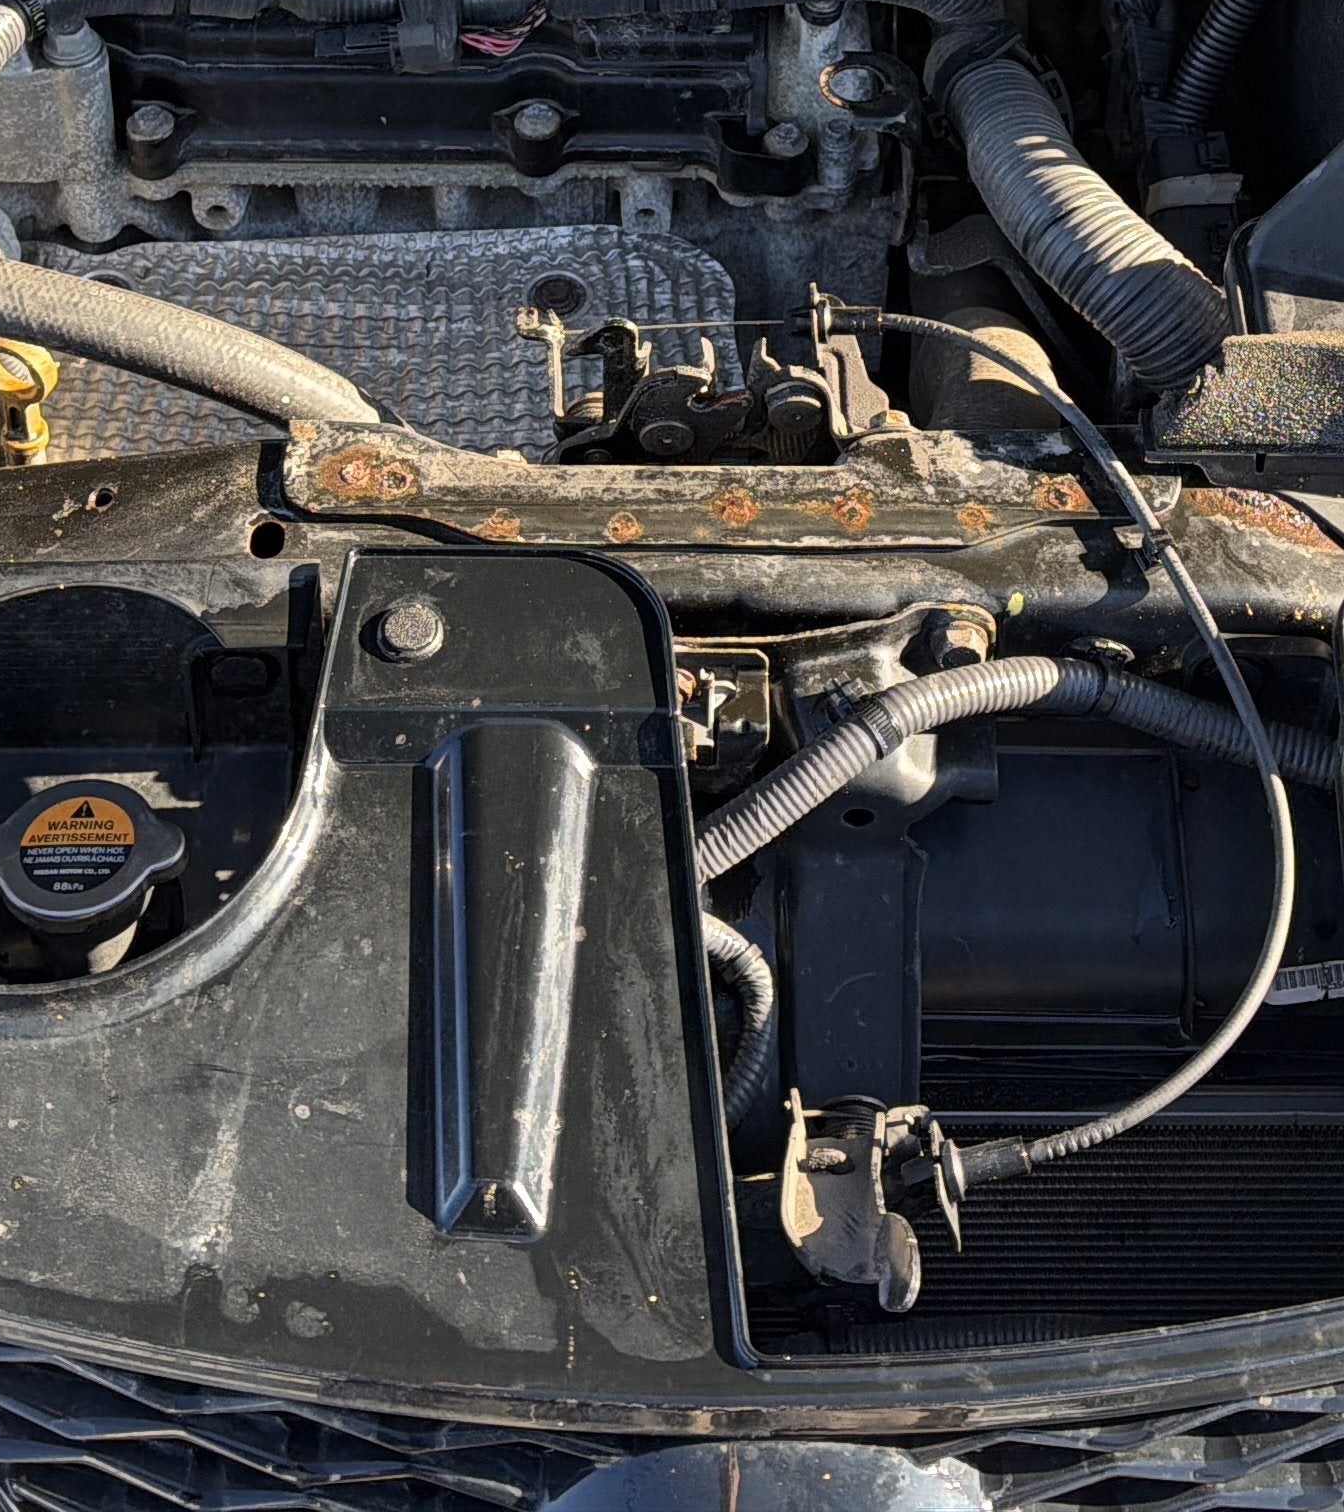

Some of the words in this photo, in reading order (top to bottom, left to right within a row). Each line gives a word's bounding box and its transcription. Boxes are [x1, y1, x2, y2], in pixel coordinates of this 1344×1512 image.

[47, 820, 115, 831] WARNING
[28, 832, 131, 843] AVERTISSEMENT
[27, 847, 55, 856] NEVER
[56, 847, 79, 855] OPEN
[80, 847, 106, 855] WHEN
[32, 855, 61, 864] JAMAIS
[33, 868, 59, 876] NISSAN
